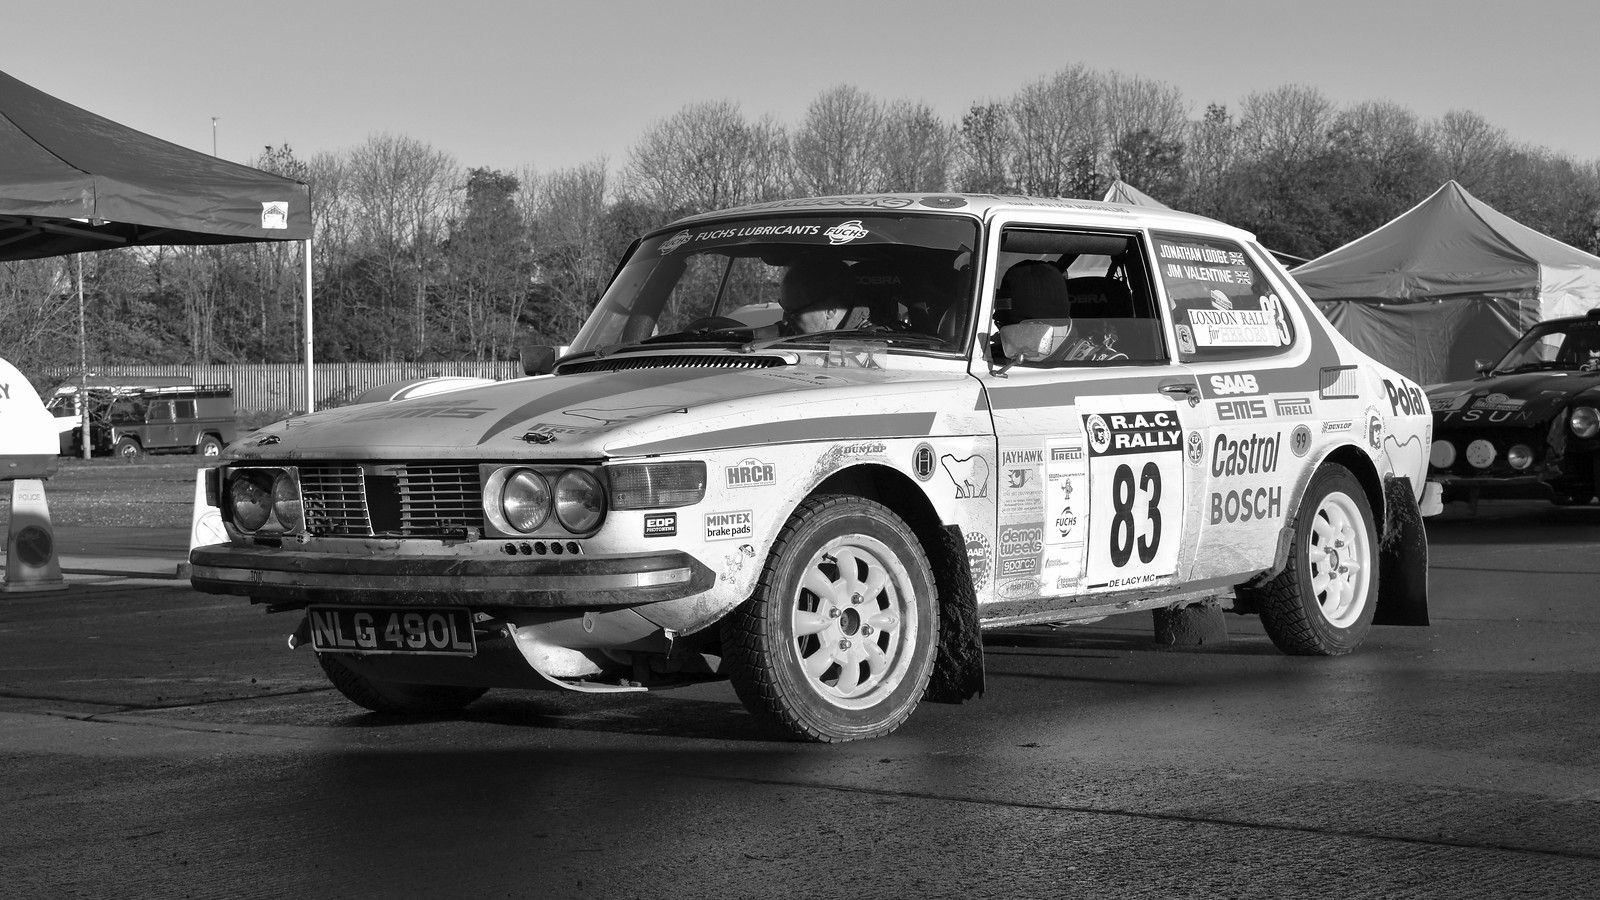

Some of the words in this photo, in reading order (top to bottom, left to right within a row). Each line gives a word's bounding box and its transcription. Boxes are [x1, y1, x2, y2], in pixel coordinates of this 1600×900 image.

[695, 229, 737, 241] FUCHS
[737, 226, 821, 238] LUBRICANTS
[826, 228, 867, 238] FUCHS
[1160, 245, 1203, 262] JONATHAN
[1201, 249, 1230, 264] LODGE
[1167, 264, 1184, 278] JIM
[1184, 266, 1234, 283] VALENTINE
[1068, 293, 1108, 304] OBRA
[1189, 311, 1238, 325] LONDON
[1240, 311, 1273, 325] RALL
[0, 383, 10, 399] Y
[1210, 374, 1259, 395] SAAB
[1383, 379, 1426, 417] Polar
[1215, 400, 1267, 420] ems
[1274, 398, 1313, 416] PIRELLI
[1443, 410, 1533, 422] TSUN
[1111, 413, 1176, 429] R.A.C.
[1328, 422, 1352, 430] DUNLOP
[1115, 431, 1181, 449] RALLY
[1296, 433, 1306, 448] 99
[1002, 450, 1043, 466] JAYHAWK
[1051, 447, 1081, 460] PIRELLI
[1212, 432, 1281, 478] Castrol
[728, 466, 774, 484] HRCR
[1211, 486, 1281, 525] BOSCH
[707, 513, 751, 526] MINTEX
[1056, 516, 1077, 528] FUCHS
[1110, 461, 1162, 568] 83
[647, 518, 674, 527] EDP
[707, 527, 731, 537] brake
[731, 525, 751, 537] pads
[1002, 529, 1041, 543] demon
[967, 549, 984, 557] AAB
[1000, 541, 1042, 556] tweeks
[1004, 559, 1036, 571] sparco
[1109, 580, 1120, 588] DE
[1121, 577, 1142, 586] LACY
[1142, 575, 1156, 583] MC
[312, 611, 378, 648] NLG
[384, 612, 473, 650] 490L
